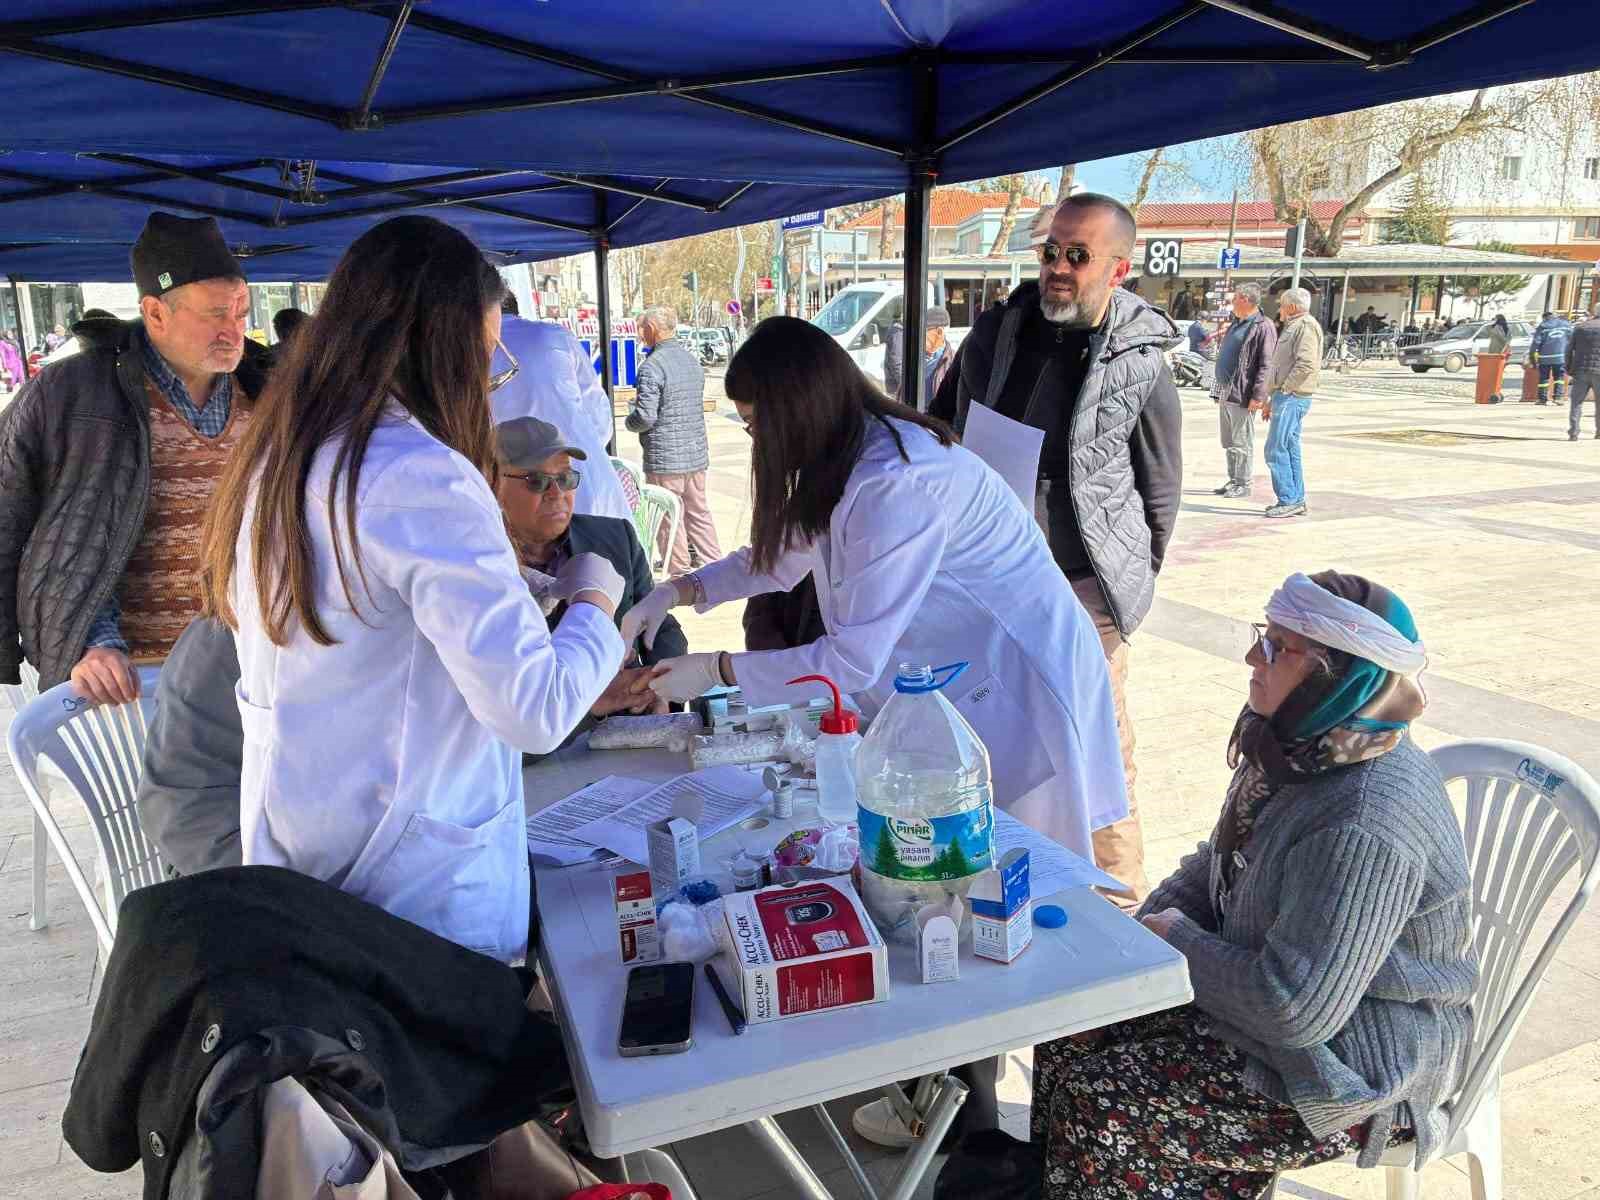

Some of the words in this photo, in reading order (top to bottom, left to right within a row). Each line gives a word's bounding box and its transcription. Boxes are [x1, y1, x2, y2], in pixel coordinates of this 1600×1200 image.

[1150, 241, 1179, 257] on
[1149, 257, 1178, 273] on
[736, 915, 760, 965] ACCU-CHEK
[754, 973, 765, 1018] ACCU-CHEK
